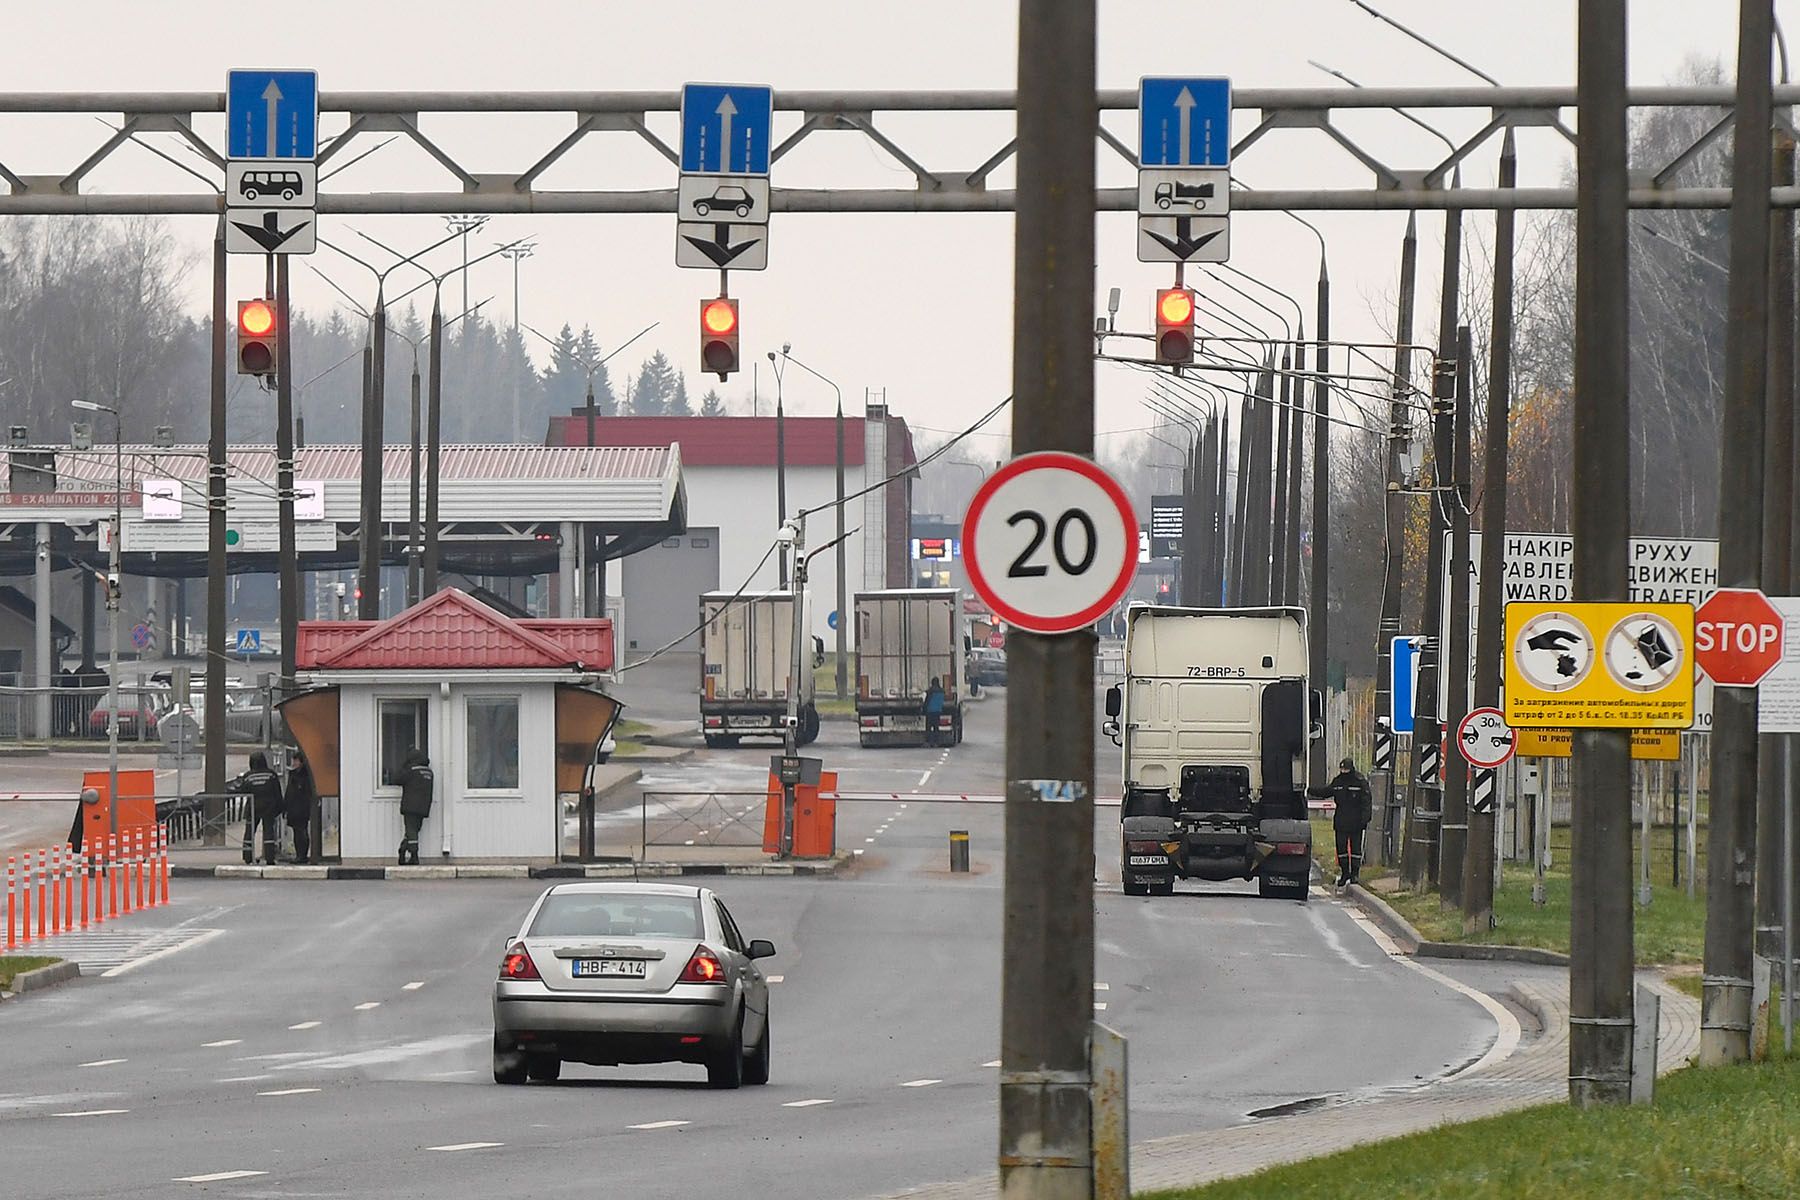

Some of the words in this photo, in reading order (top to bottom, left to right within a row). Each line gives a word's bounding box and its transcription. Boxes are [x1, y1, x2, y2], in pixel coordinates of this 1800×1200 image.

[22, 494, 98, 505] EXAMINATION
[1007, 507, 1097, 577] 20
[1508, 539, 1573, 557] НАКІР
[1635, 543, 1692, 561] РУХУ
[1628, 565, 1717, 585] ДВИЖЕН
[1694, 621, 1779, 653] STOP
[1187, 666, 1246, 677] 72-BRP-5
[1514, 698, 1524, 706] За
[1661, 700, 1687, 708] дорог
[1514, 710, 1544, 719] штраф
[581, 961, 609, 973] HBF
[619, 961, 643, 973] 414
